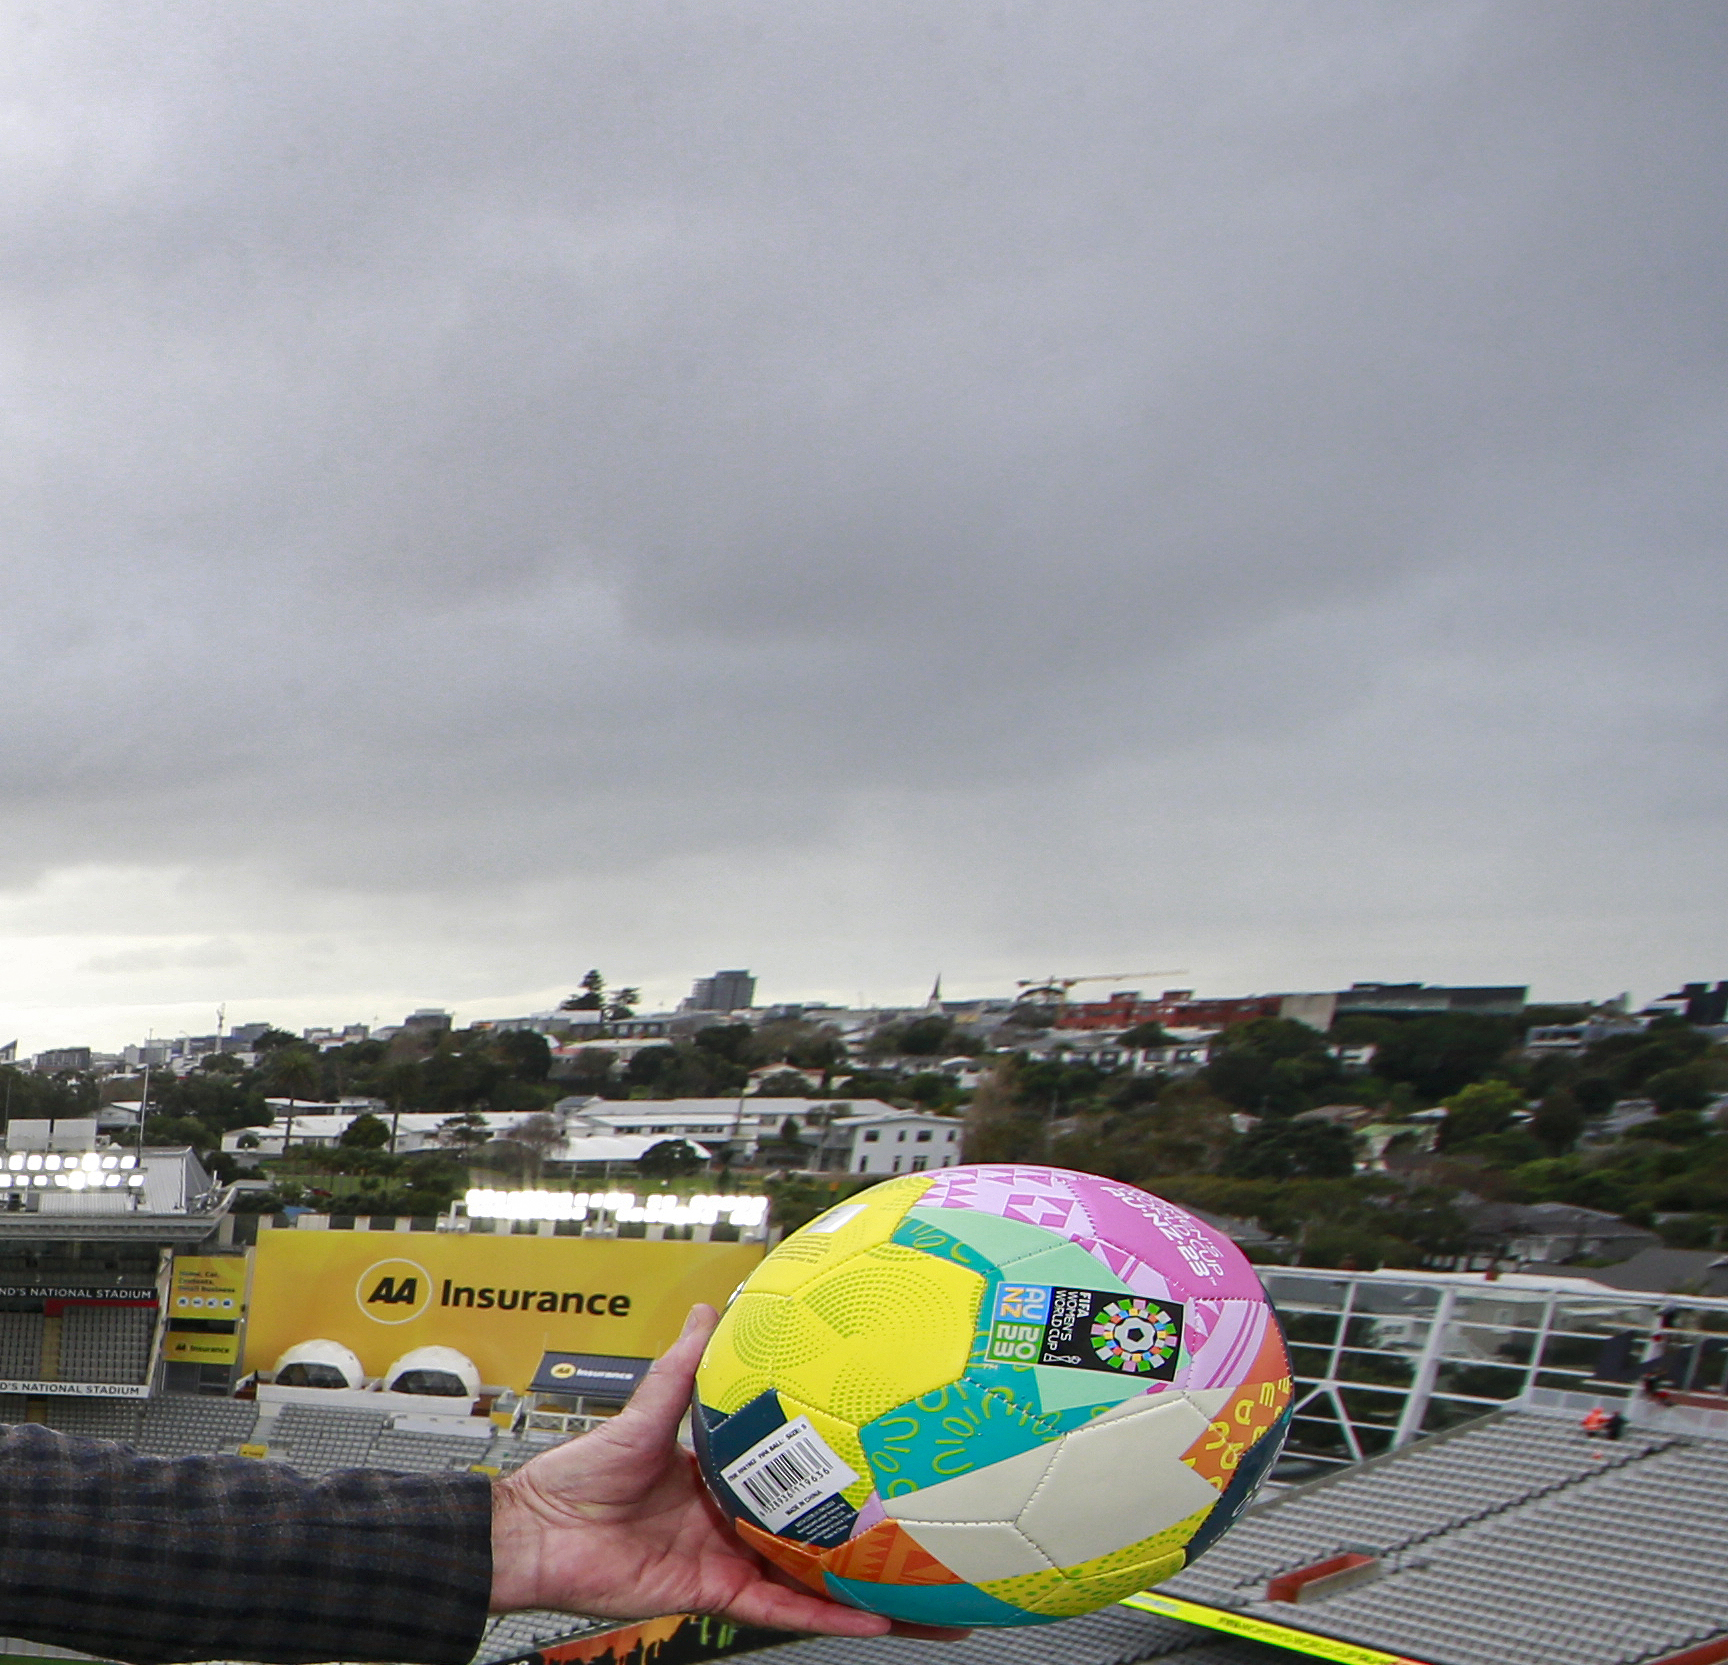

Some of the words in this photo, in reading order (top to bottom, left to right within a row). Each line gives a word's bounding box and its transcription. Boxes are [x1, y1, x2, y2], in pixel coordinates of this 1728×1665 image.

[1189, 1238, 1225, 1278] CUP
[30, 1287, 92, 1298] NATIONAL
[96, 1288, 151, 1299] STADIUM
[367, 1277, 417, 1304] AA
[441, 1280, 630, 1316] Insurance
[1000, 1287, 1025, 1318] NZ
[1023, 1288, 1047, 1319] AU
[1052, 1290, 1066, 1327] WORLD
[1077, 1292, 1091, 1318] FIFA
[1060, 1292, 1078, 1341] WOMEN'S
[1047, 1329, 1059, 1350] CUP
[21, 1383, 83, 1393] NATIONAL
[86, 1385, 139, 1395] STADIUM
[576, 1368, 634, 1380] Insurance
